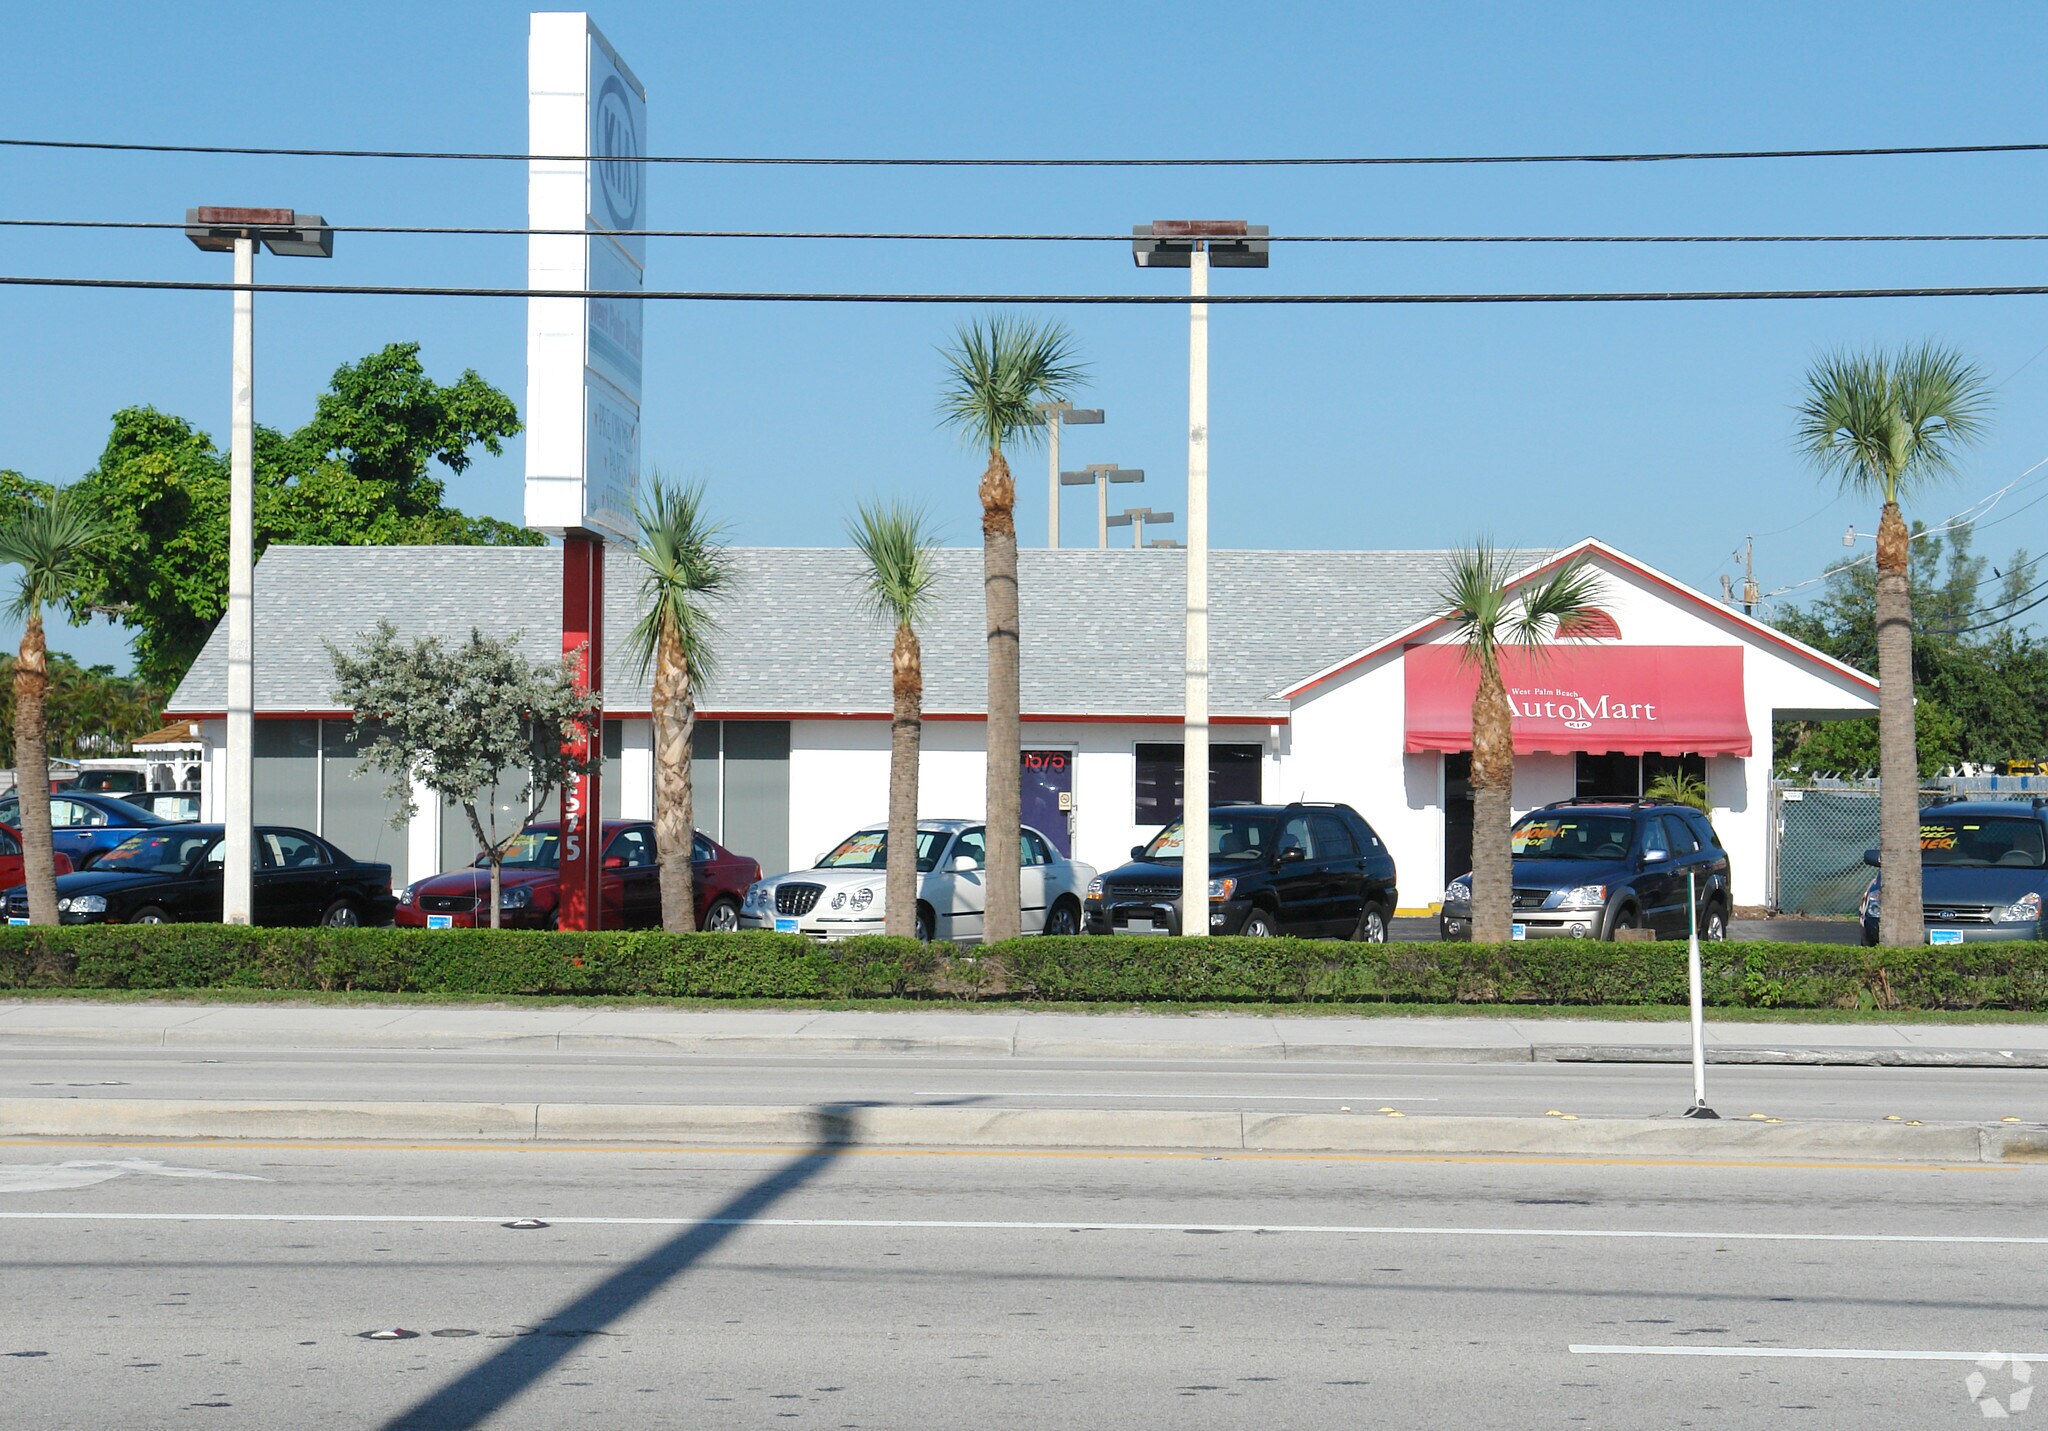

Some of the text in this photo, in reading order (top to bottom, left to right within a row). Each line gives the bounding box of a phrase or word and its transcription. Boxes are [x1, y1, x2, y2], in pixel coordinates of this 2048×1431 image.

[603, 104, 634, 209] KIA
[1511, 687, 1579, 698] West Palm Beach
[1505, 693, 1657, 721] AutoMart
[1025, 751, 1066, 769] 1575
